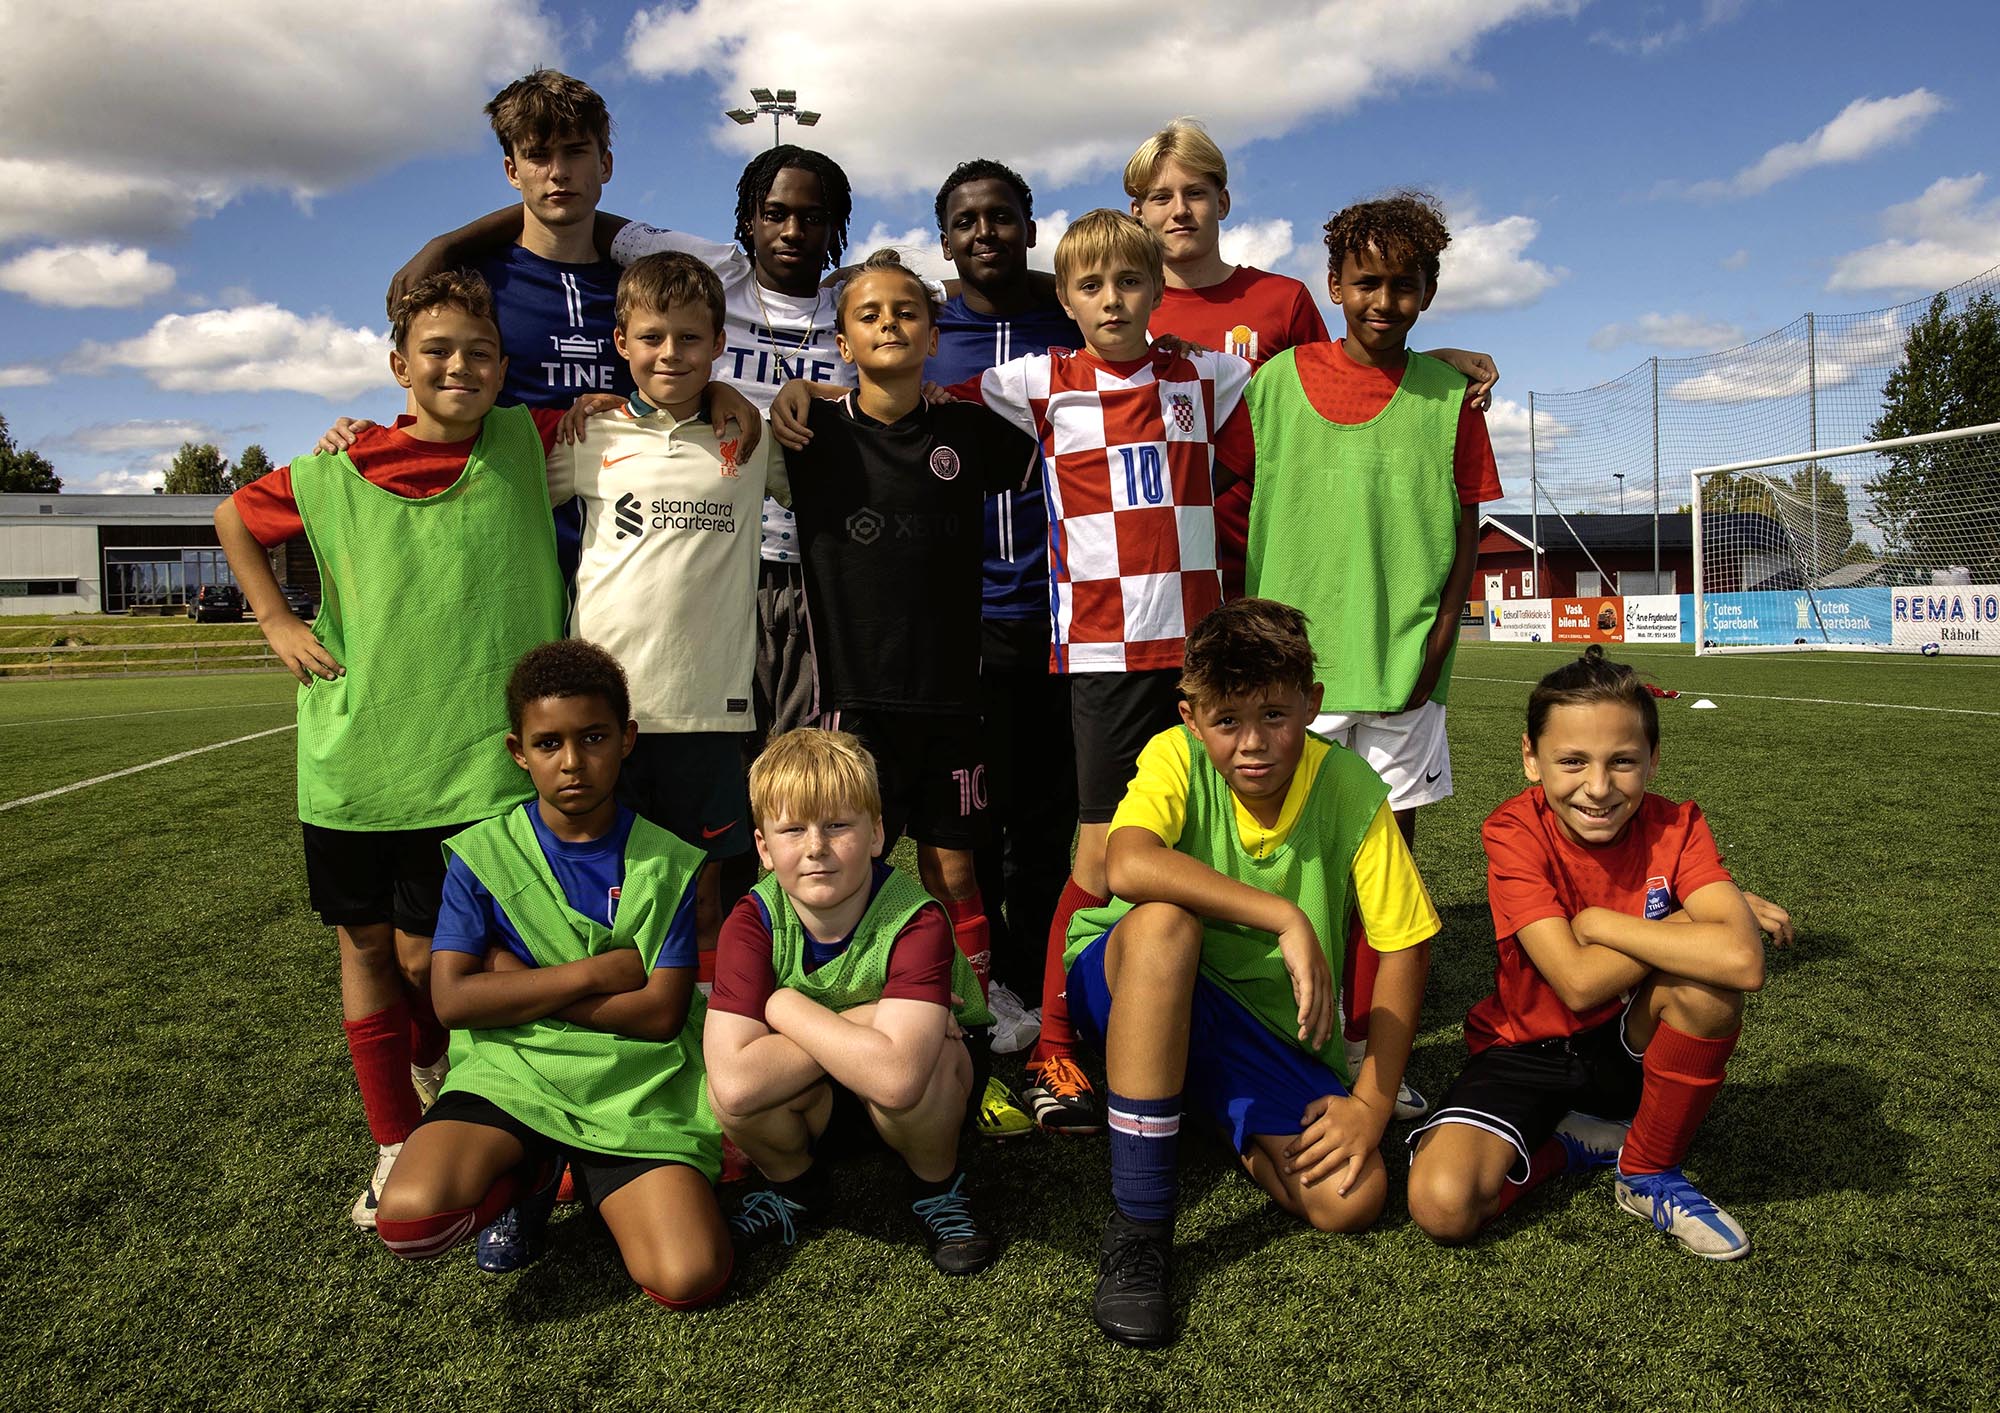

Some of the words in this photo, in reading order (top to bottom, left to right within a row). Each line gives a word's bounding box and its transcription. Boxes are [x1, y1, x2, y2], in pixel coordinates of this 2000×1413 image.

[727, 346, 835, 386] TINE
[541, 362, 615, 390] TINE
[1118, 445, 1164, 506] 10
[652, 498, 733, 518] standard
[652, 515, 735, 533] chartered
[1565, 604, 1583, 615] Vask
[1713, 602, 1742, 615] Totens
[1815, 602, 1850, 614] Totens
[1894, 595, 1966, 622] REMA
[1558, 616, 1577, 628] bilen
[1578, 615, 1590, 628] nå!
[1636, 614, 1648, 622] Arve
[1648, 613, 1677, 624] Frydenlund
[1712, 616, 1759, 632] Sparebank
[1941, 627, 1980, 641] Råholt
[952, 764, 988, 816] 10
[1648, 901, 1666, 911] TINE
